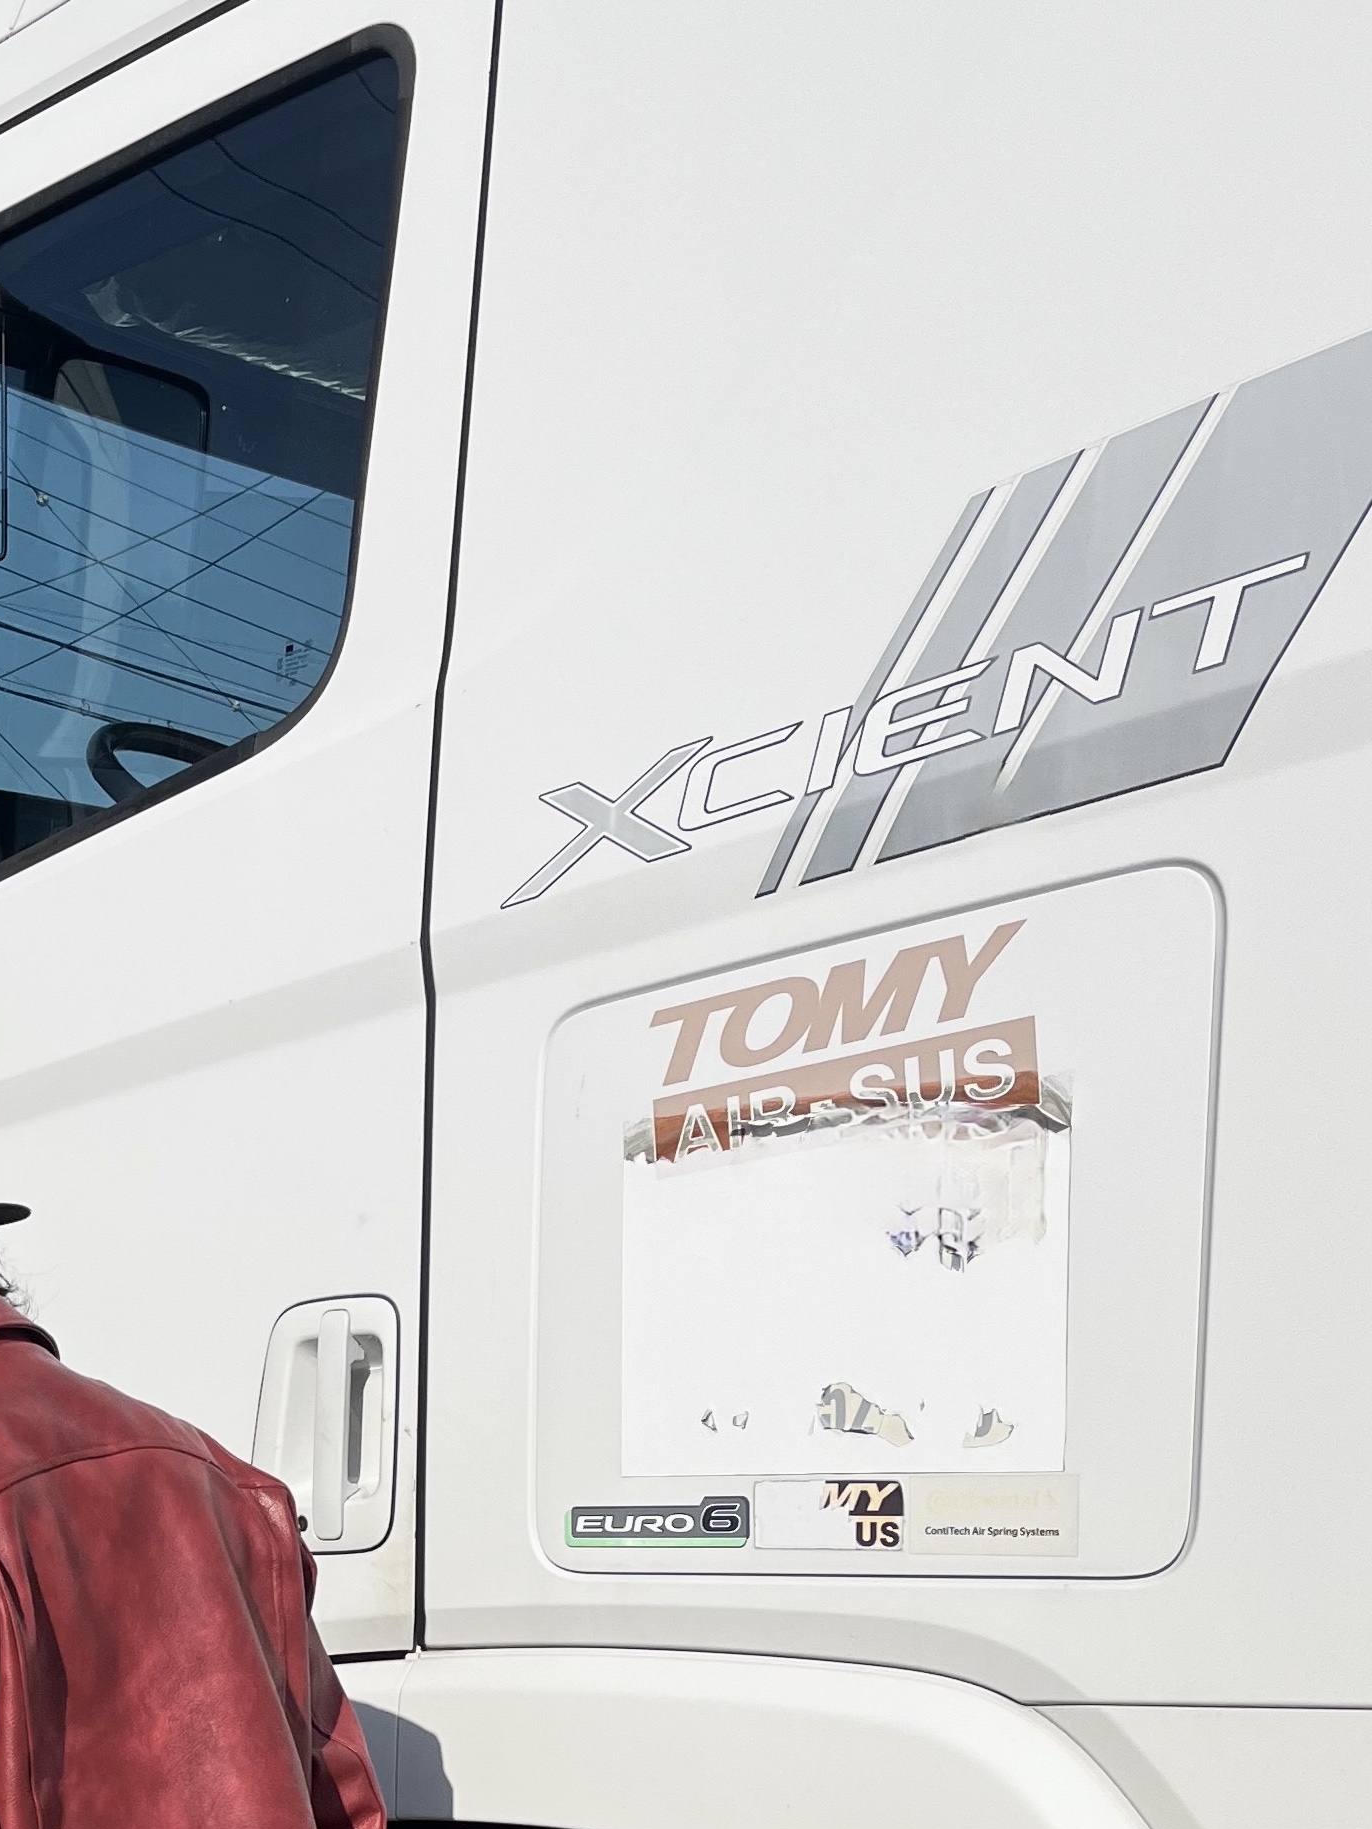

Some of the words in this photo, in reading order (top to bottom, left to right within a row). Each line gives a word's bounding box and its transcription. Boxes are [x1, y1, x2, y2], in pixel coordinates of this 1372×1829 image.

[500, 552, 1311, 909] XCIENT
[649, 919, 1027, 1087] TOMY
[575, 1513, 695, 1534] EURO
[700, 1502, 742, 1534] 6
[925, 1526, 970, 1536] ContiTech
[972, 1526, 985, 1536] Air
[987, 1526, 1018, 1538] Spring
[1019, 1527, 1060, 1538] Systems
